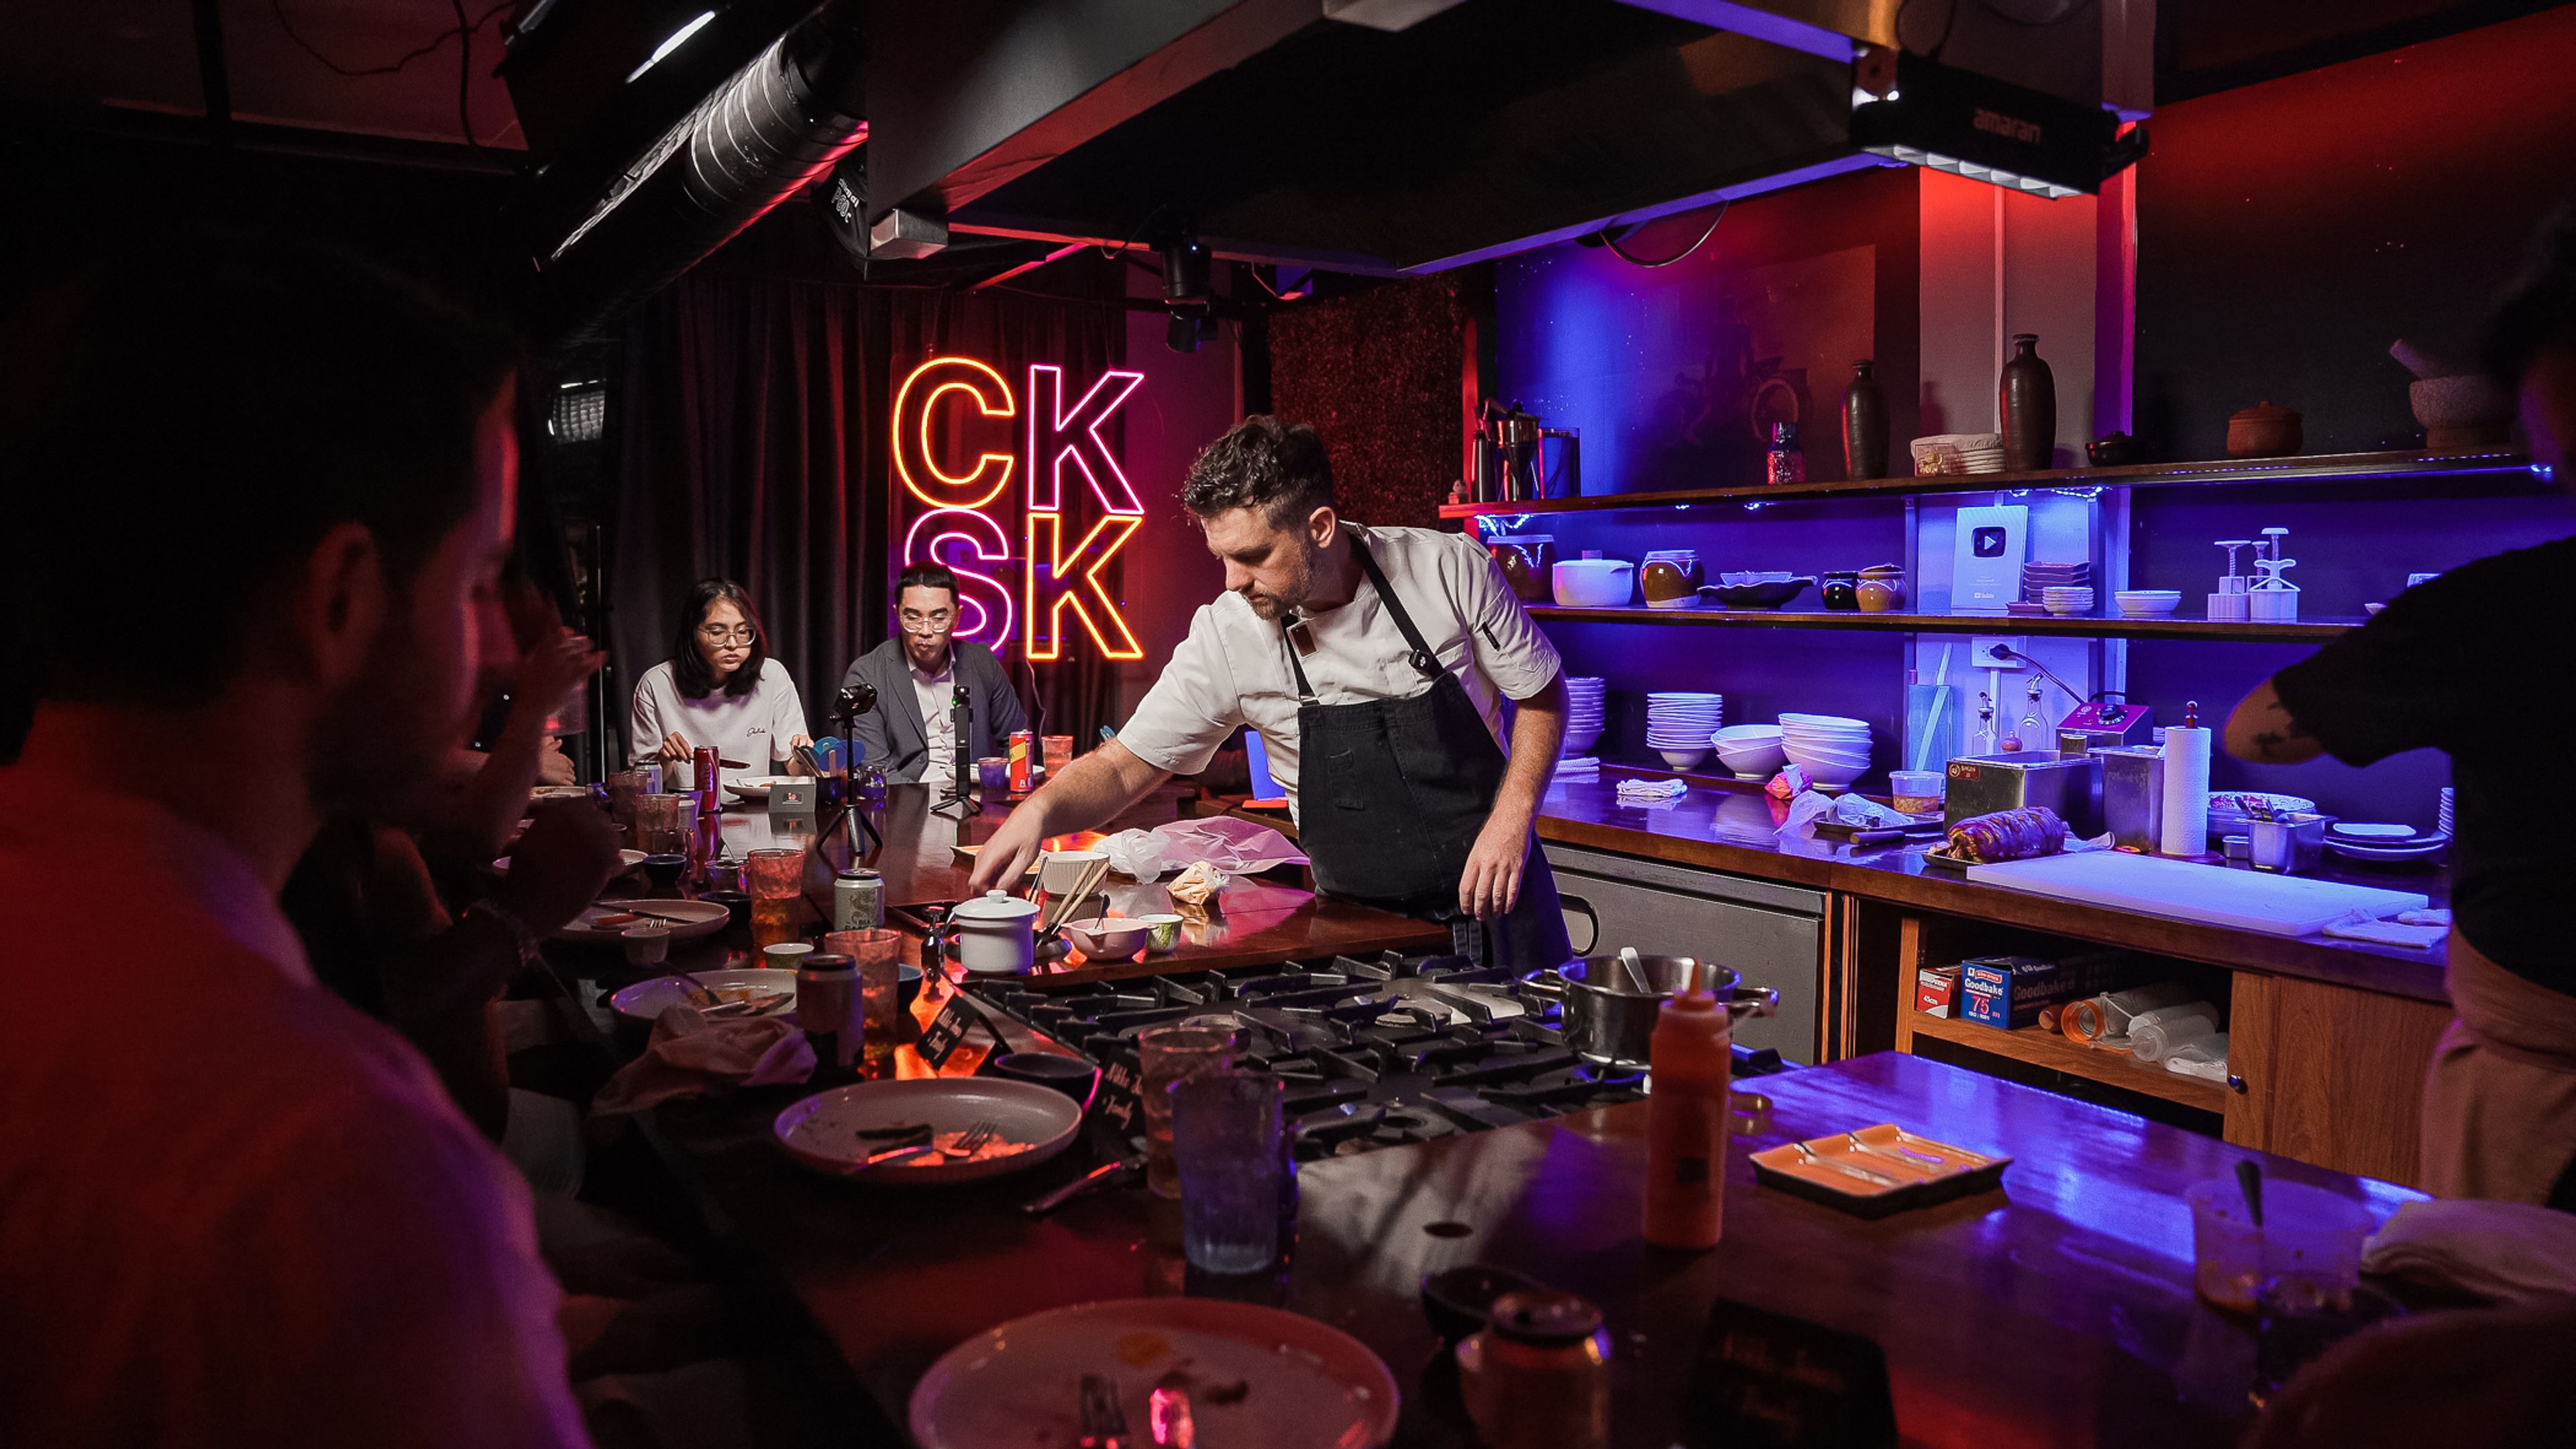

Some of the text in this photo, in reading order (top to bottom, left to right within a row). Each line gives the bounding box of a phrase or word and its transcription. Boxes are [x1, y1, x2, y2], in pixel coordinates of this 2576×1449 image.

[1973, 108, 2041, 144] amaran
[892, 356, 1145, 515] CK
[904, 507, 1144, 660] SK
[1964, 978, 2003, 996] Goodbake
[1972, 996, 1990, 1015] 75
